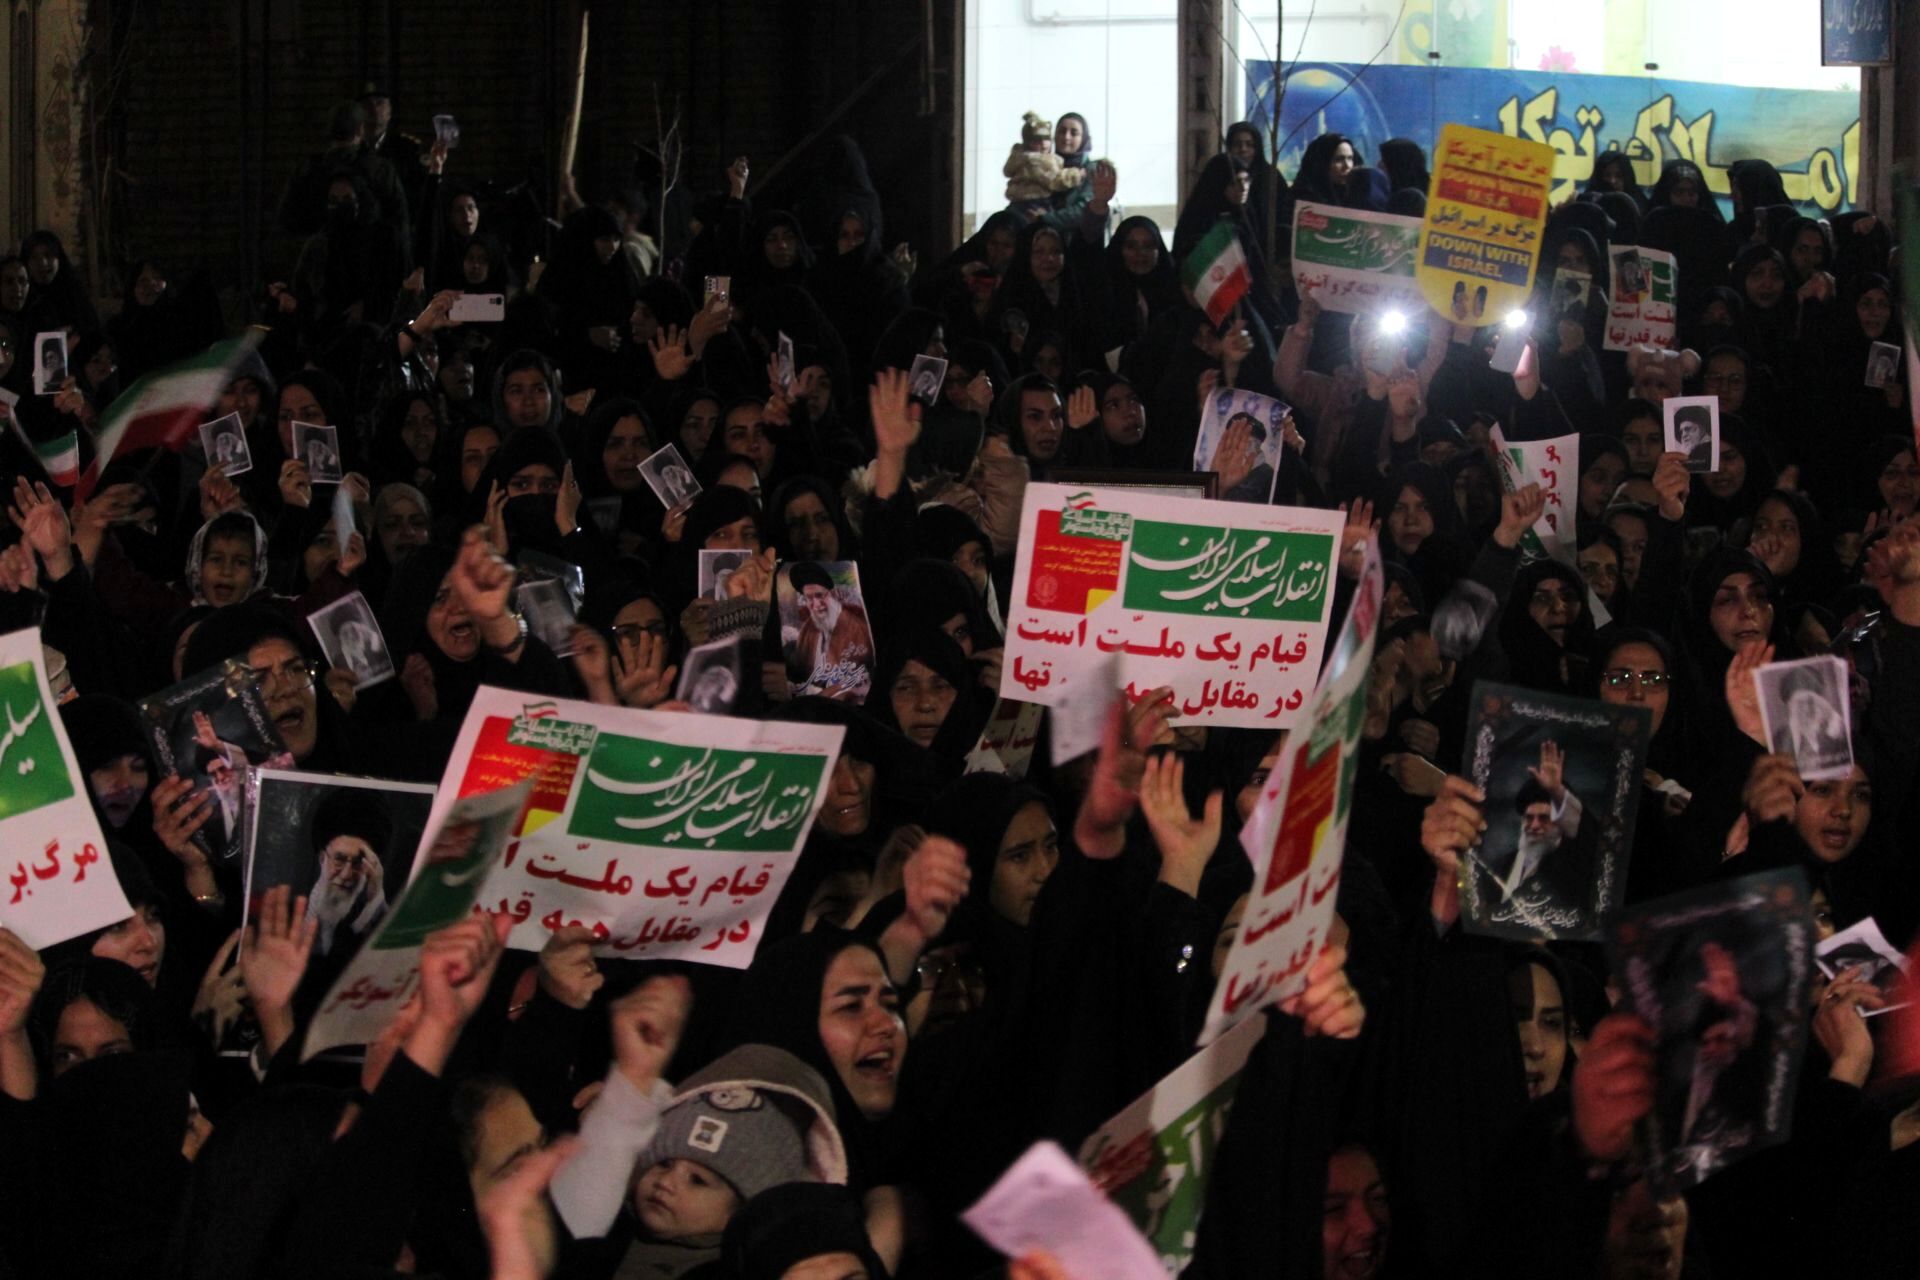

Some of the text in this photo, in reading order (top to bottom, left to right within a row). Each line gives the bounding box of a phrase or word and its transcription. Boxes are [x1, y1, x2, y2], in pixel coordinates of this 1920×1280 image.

[1429, 233, 1482, 253] DOWN
[1485, 245, 1530, 267] WITH
[1447, 254, 1503, 278] ISRAEL
[1131, 527, 1237, 580] ایران
[1160, 536, 1288, 612] اسلامی
[1219, 559, 1326, 616] انقلاب
[1017, 617, 1087, 648] است
[1195, 631, 1241, 670] یک
[1249, 631, 1308, 673] قیام
[1182, 678, 1259, 717] مقابل
[1264, 687, 1303, 719] در
[587, 746, 718, 808] ایران
[614, 757, 774, 843] اسلامی
[684, 784, 815, 848] انقلاب
[9, 838, 99, 904] مرگ بر
[644, 865, 697, 907] یک
[700, 863, 774, 907] قیام
[1244, 875, 1307, 945] است
[612, 915, 700, 951] مقابل
[701, 914, 749, 951] در
